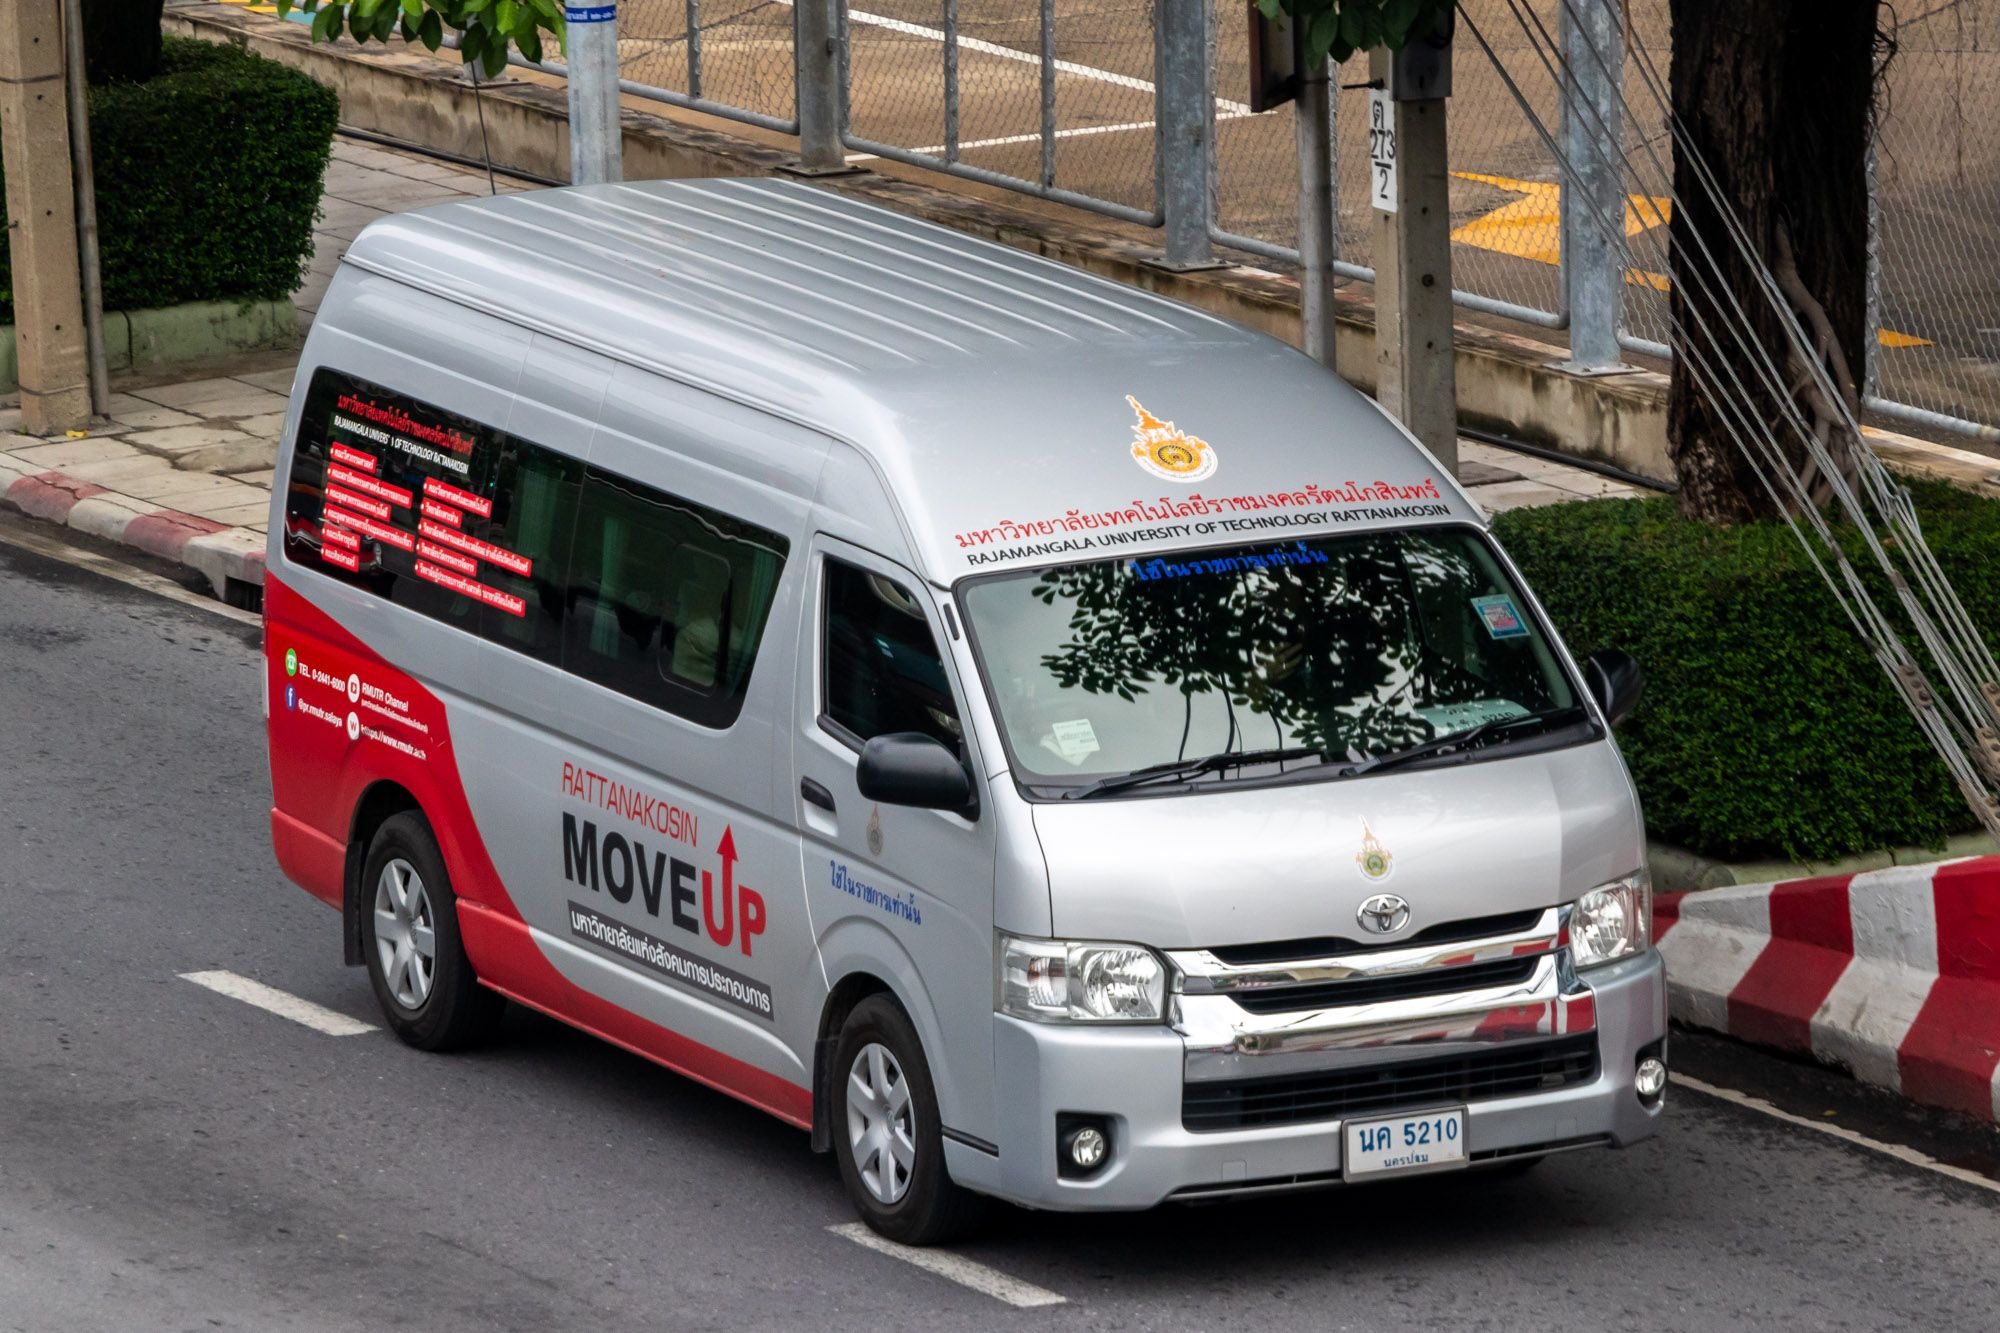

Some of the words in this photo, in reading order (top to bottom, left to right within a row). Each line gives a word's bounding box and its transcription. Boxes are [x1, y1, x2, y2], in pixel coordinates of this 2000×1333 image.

[1370, 129, 1396, 160] 273
[1380, 168, 1388, 199] 2
[334, 415, 369, 438] RAJAMANGALA
[401, 440, 434, 459] TECHNOLOGY
[955, 478, 1441, 548] มหาวิทยาลัยเทคโนโลยีราชมงคลรัตนโกสินทร์
[967, 537, 1097, 566] RAJAMANGALA
[1097, 524, 1192, 546] UNIVERSITY
[1195, 522, 1218, 535] OF
[1218, 512, 1331, 532] TECHNOLOGY
[1330, 503, 1452, 523] RATTANAKOSIN
[1129, 541, 1329, 581] ใช้ในราชการเท่านั้น
[312, 668, 346, 692] 0-2441-6000
[361, 682, 385, 702] RMUTR
[384, 692, 409, 712] Channel
[562, 762, 698, 847] RATTANAKOSIN
[830, 860, 921, 925] ใช้ในราชการเท่านั้น
[571, 909, 771, 1013] มหาวิทยาลัยแห่งสังคมการประกอบการ
[1360, 1127, 1391, 1152] นค
[1404, 1118, 1458, 1146] 5210
